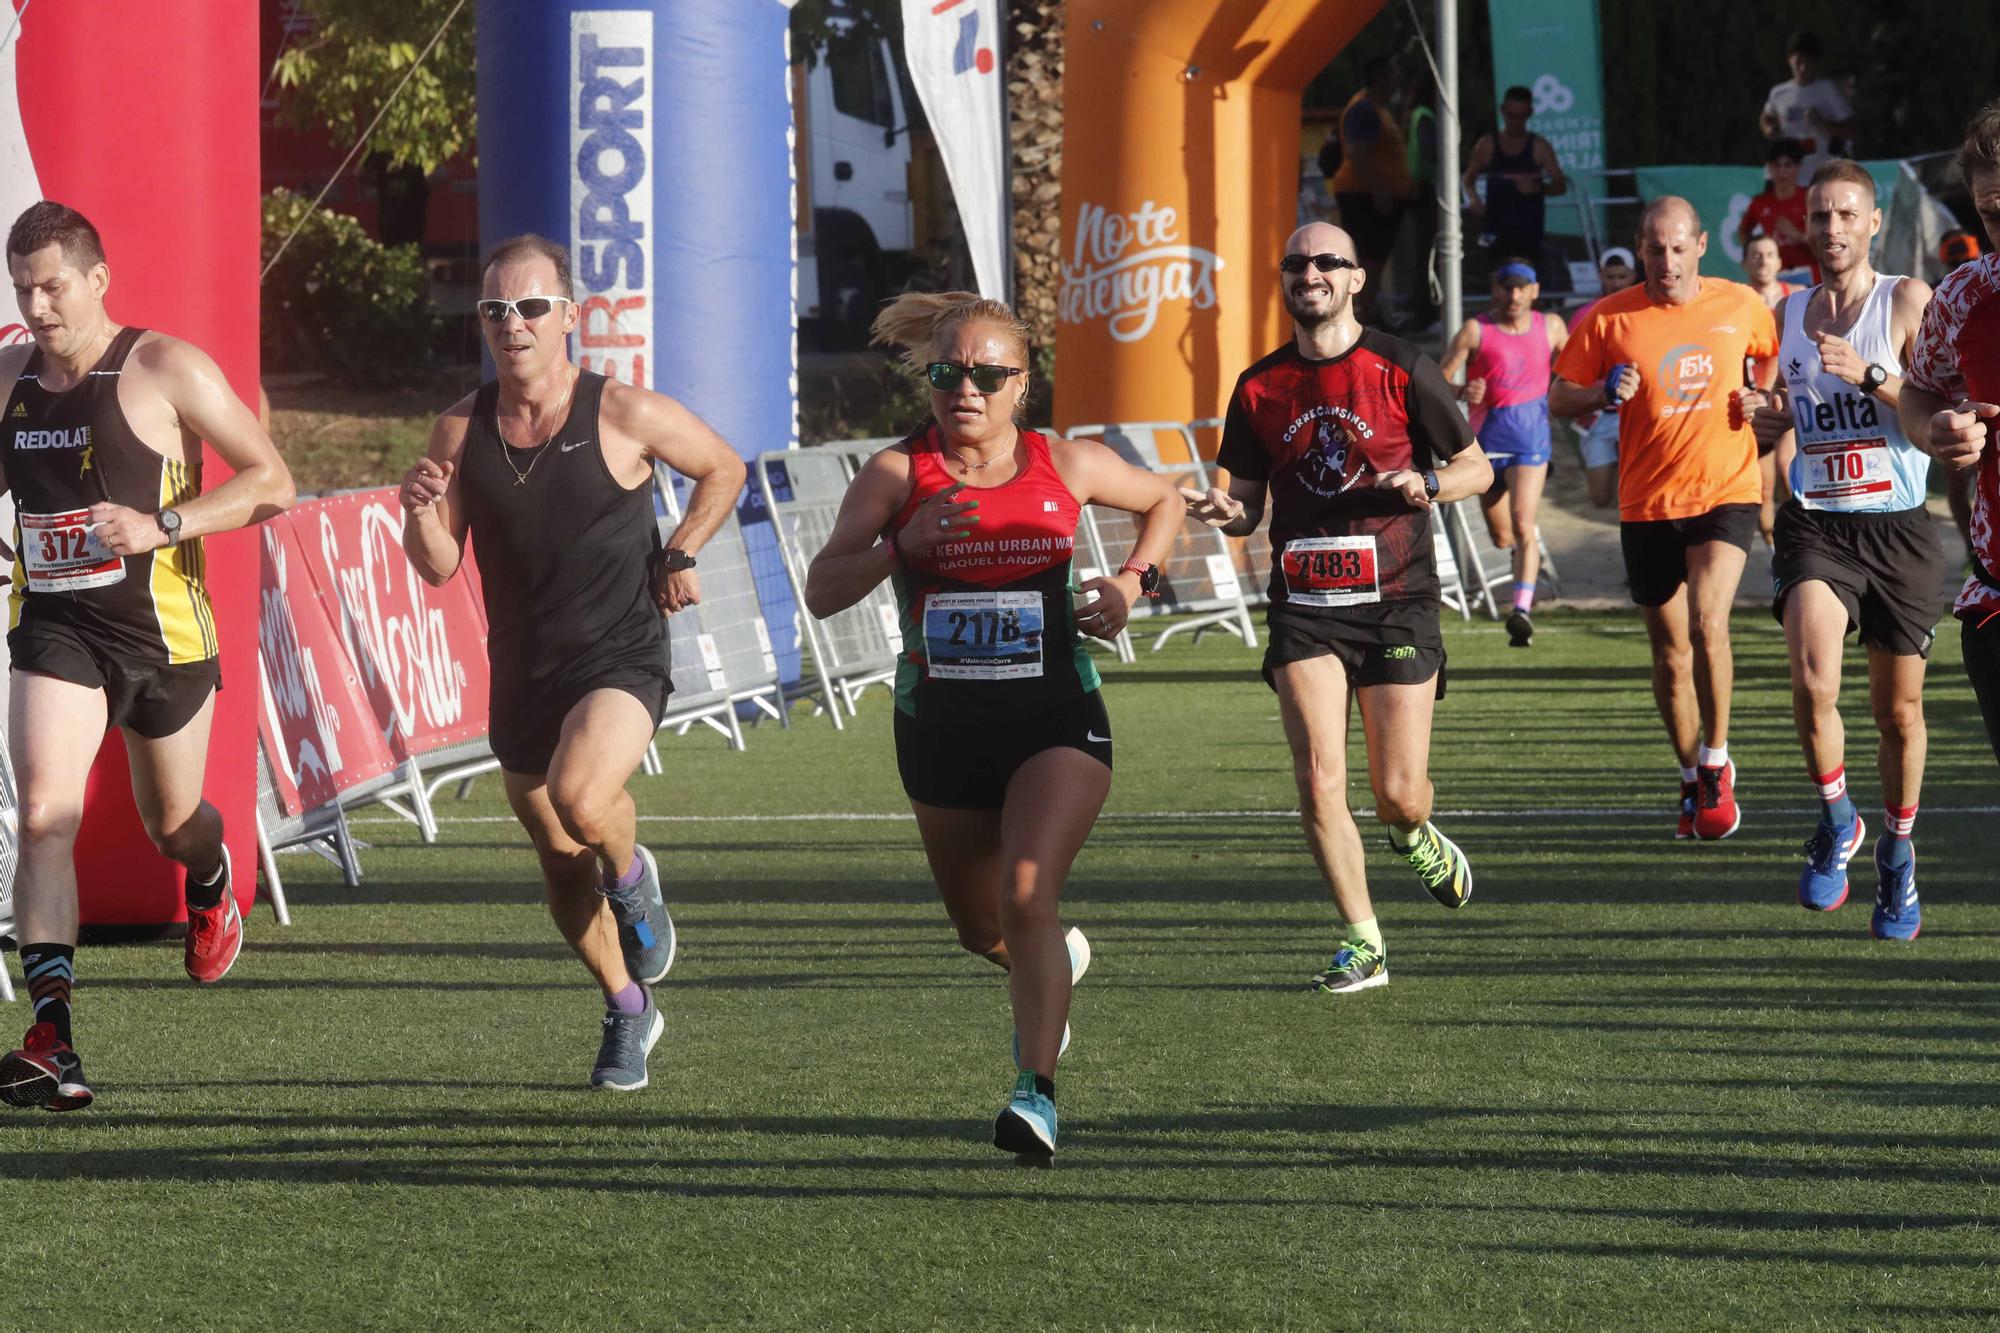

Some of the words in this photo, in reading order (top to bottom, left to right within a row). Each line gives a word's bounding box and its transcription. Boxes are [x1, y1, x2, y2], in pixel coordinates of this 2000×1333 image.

[1074, 201, 1134, 270] No
[1130, 200, 1179, 246] te
[1058, 245, 1226, 342] detengas
[1679, 353, 1713, 378] 15K
[1283, 405, 1374, 442] CORRECANSINOS
[1795, 393, 1879, 433] Delta
[14, 425, 88, 450] REDOLAT
[1823, 452, 1864, 482] 170
[38, 527, 91, 562] 372
[936, 541, 994, 557] KENYAN
[1000, 538, 1051, 552] URBAN
[939, 556, 994, 571] RAQUEL
[1000, 554, 1051, 566] LANDÍN
[1295, 551, 1361, 578] 2483
[948, 610, 1020, 648] 2178
